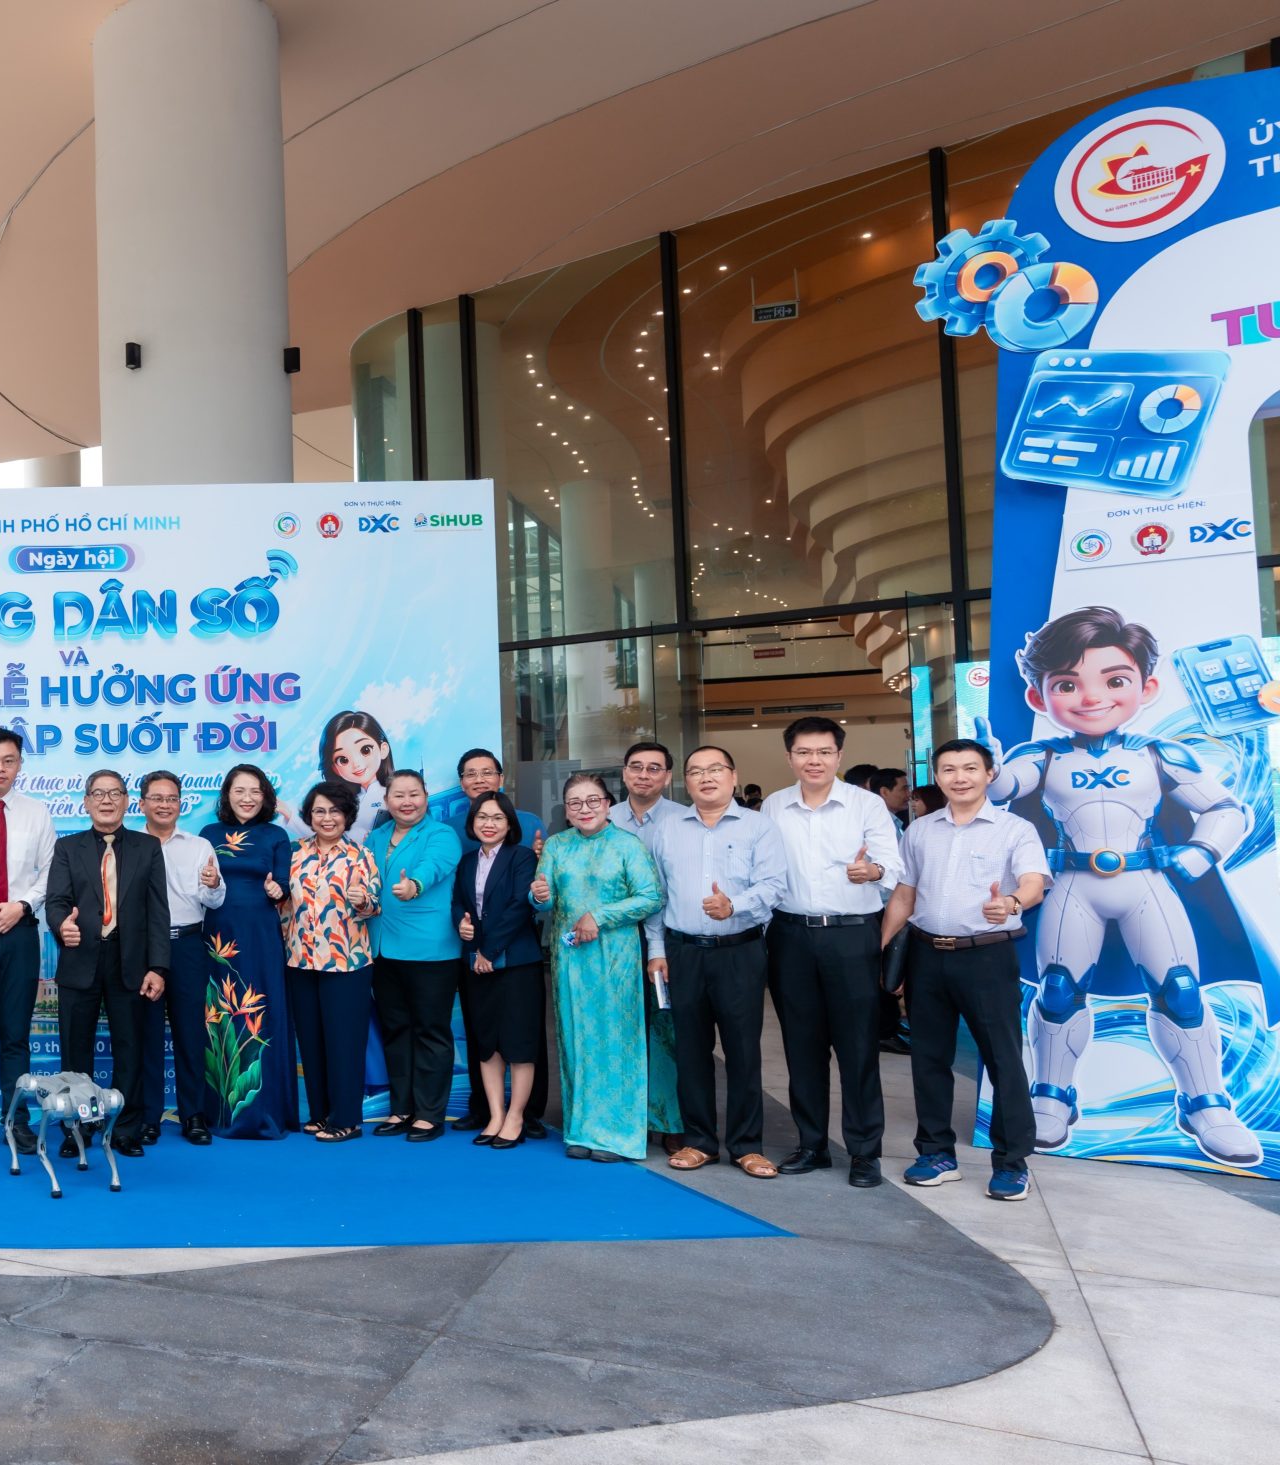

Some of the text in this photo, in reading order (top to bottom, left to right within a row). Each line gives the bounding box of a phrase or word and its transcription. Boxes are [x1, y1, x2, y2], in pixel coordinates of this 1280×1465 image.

[1248, 118, 1280, 146] Ủ
[21, 513, 60, 533] PHỐ
[66, 512, 92, 532] HỒ
[97, 513, 128, 531] CHÍ
[133, 516, 181, 531] MINH
[358, 513, 400, 533] DXC
[1107, 508, 1131, 518] ĐƠN
[1133, 508, 1143, 516] VỊ
[1189, 517, 1252, 544] DXC
[29, 548, 115, 569] Ngày hội
[53, 578, 178, 637] DÂN
[190, 574, 280, 636] SỐ
[59, 646, 89, 666] VÀ
[40, 663, 197, 706] HƯỞNG
[204, 664, 302, 705] ỨNG
[74, 711, 189, 755] SUỐT
[193, 712, 278, 753] ĐỜI
[1071, 766, 1130, 789] DXC
